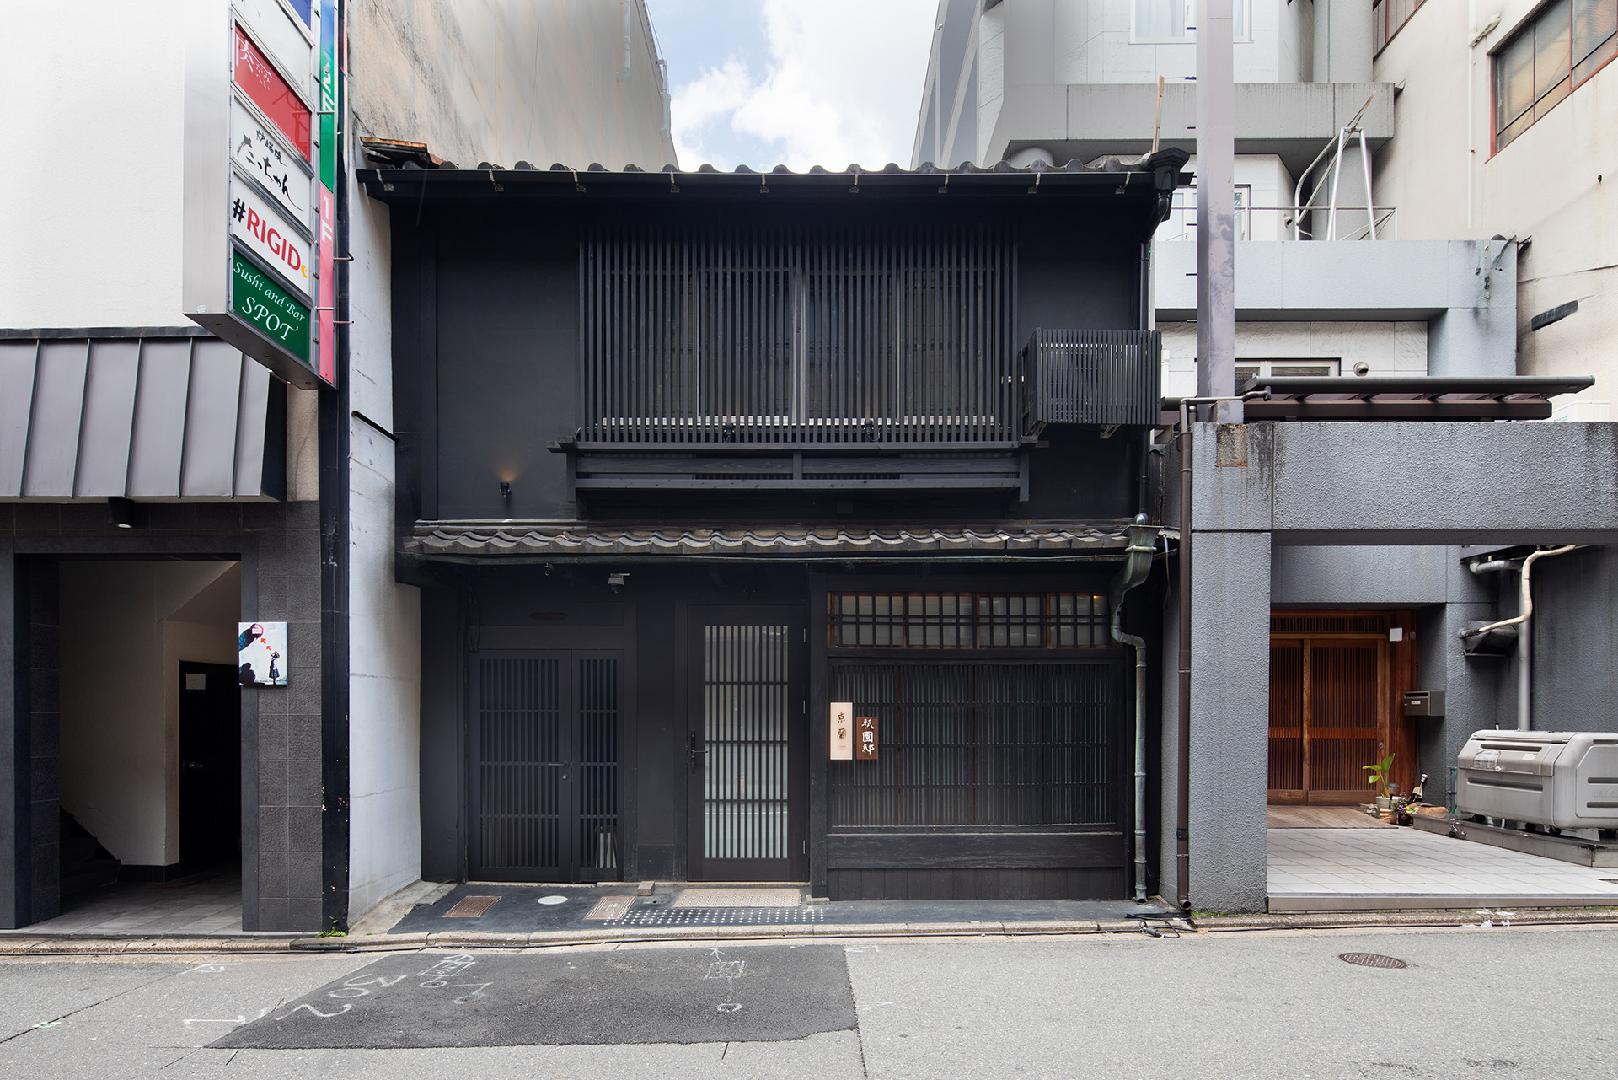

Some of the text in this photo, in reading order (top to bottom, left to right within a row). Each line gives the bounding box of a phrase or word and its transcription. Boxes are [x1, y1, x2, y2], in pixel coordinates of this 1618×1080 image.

[233, 198, 301, 271] #RIGID
[233, 262, 305, 321] Sushi and Bar
[242, 296, 299, 340] SPOT
